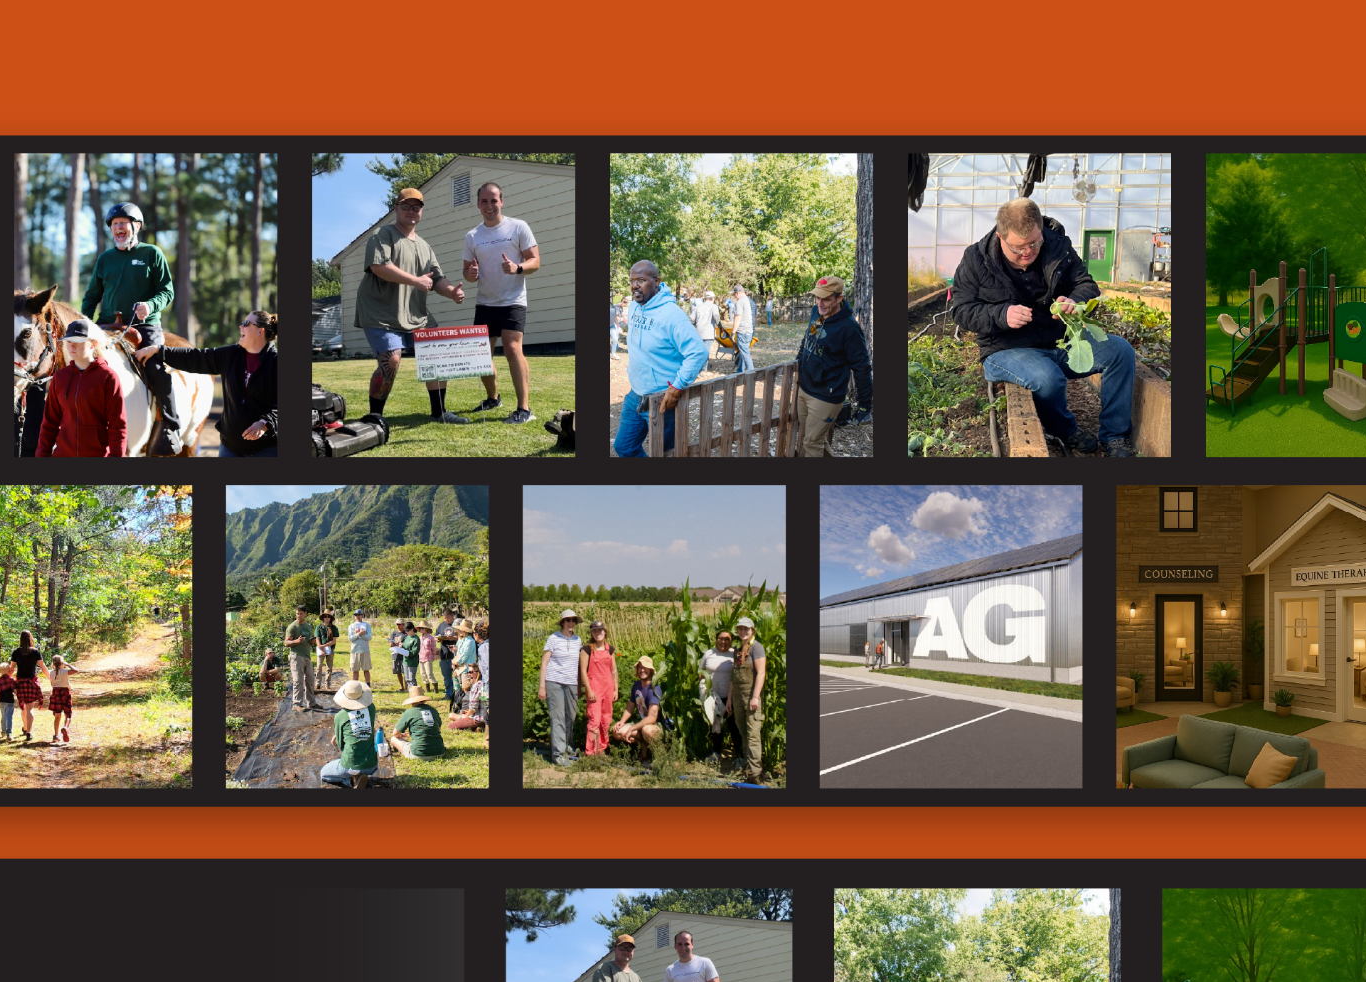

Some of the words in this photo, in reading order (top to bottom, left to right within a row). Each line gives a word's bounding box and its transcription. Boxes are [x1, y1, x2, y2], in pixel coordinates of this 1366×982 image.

[415, 329, 458, 338] VOLUNTEERS
[459, 327, 487, 335] WANTED
[1144, 569, 1214, 579] COUNSELING
[1295, 570, 1329, 582] EQUINE
[912, 583, 1047, 664] AG
